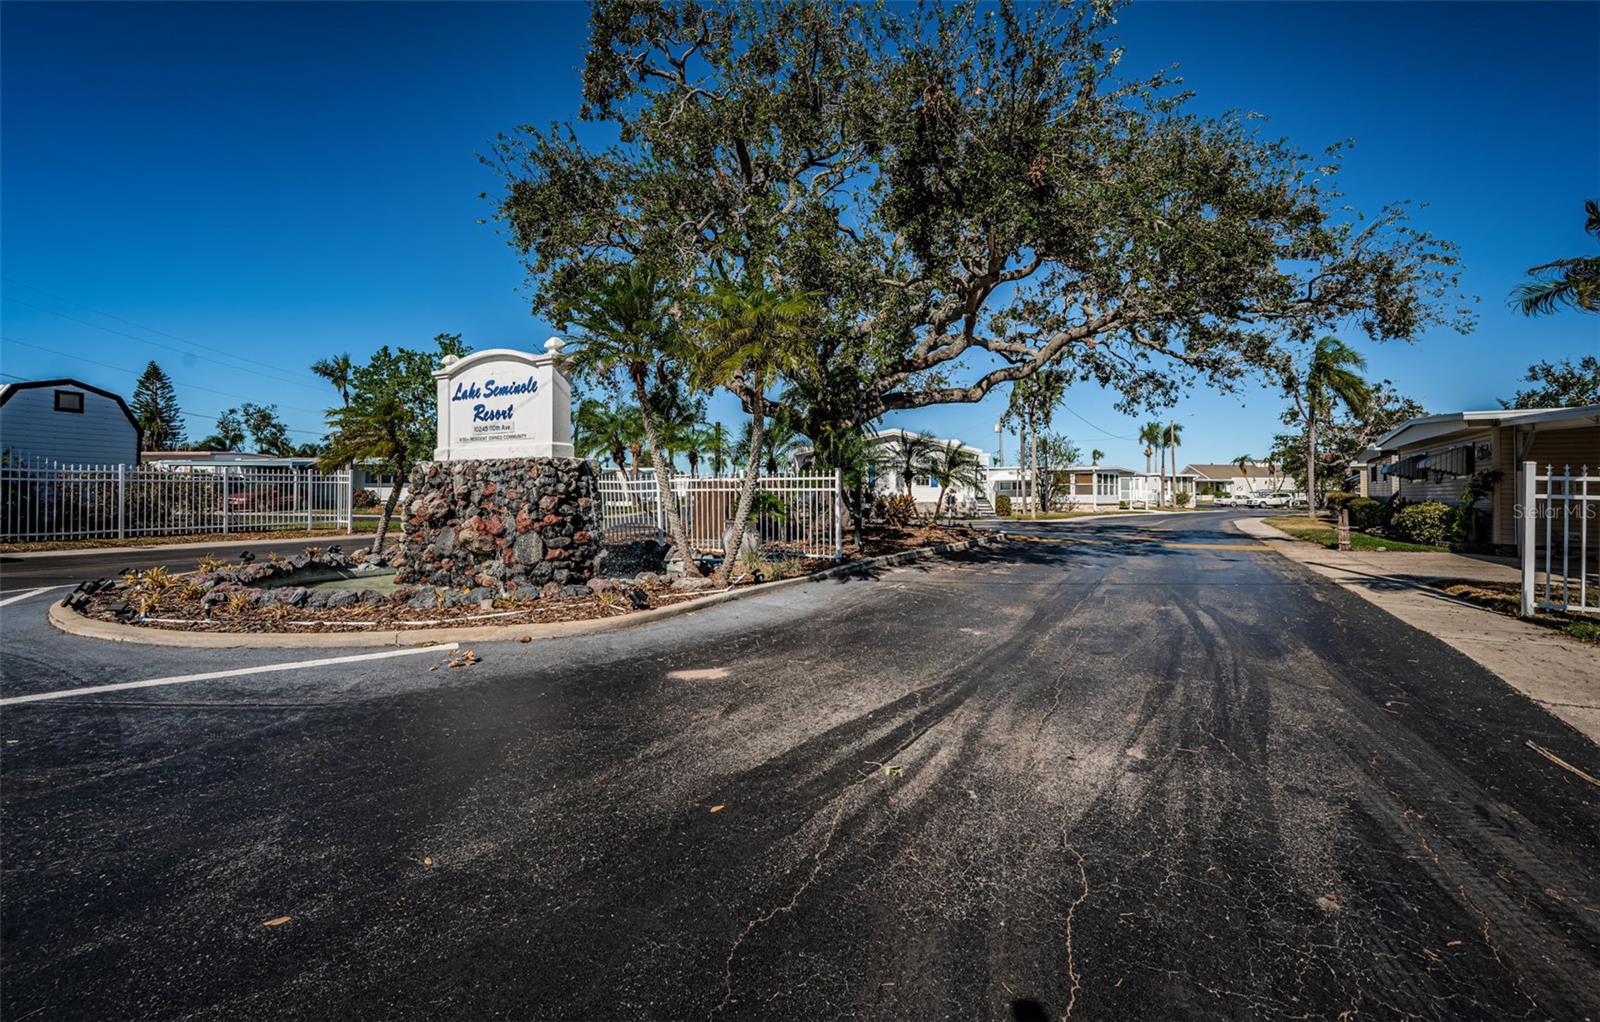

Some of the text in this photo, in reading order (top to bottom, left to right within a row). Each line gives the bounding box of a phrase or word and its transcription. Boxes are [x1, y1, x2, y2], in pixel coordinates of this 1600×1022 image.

[452, 376, 538, 401] Lake Seminole
[473, 404, 514, 422] Resort
